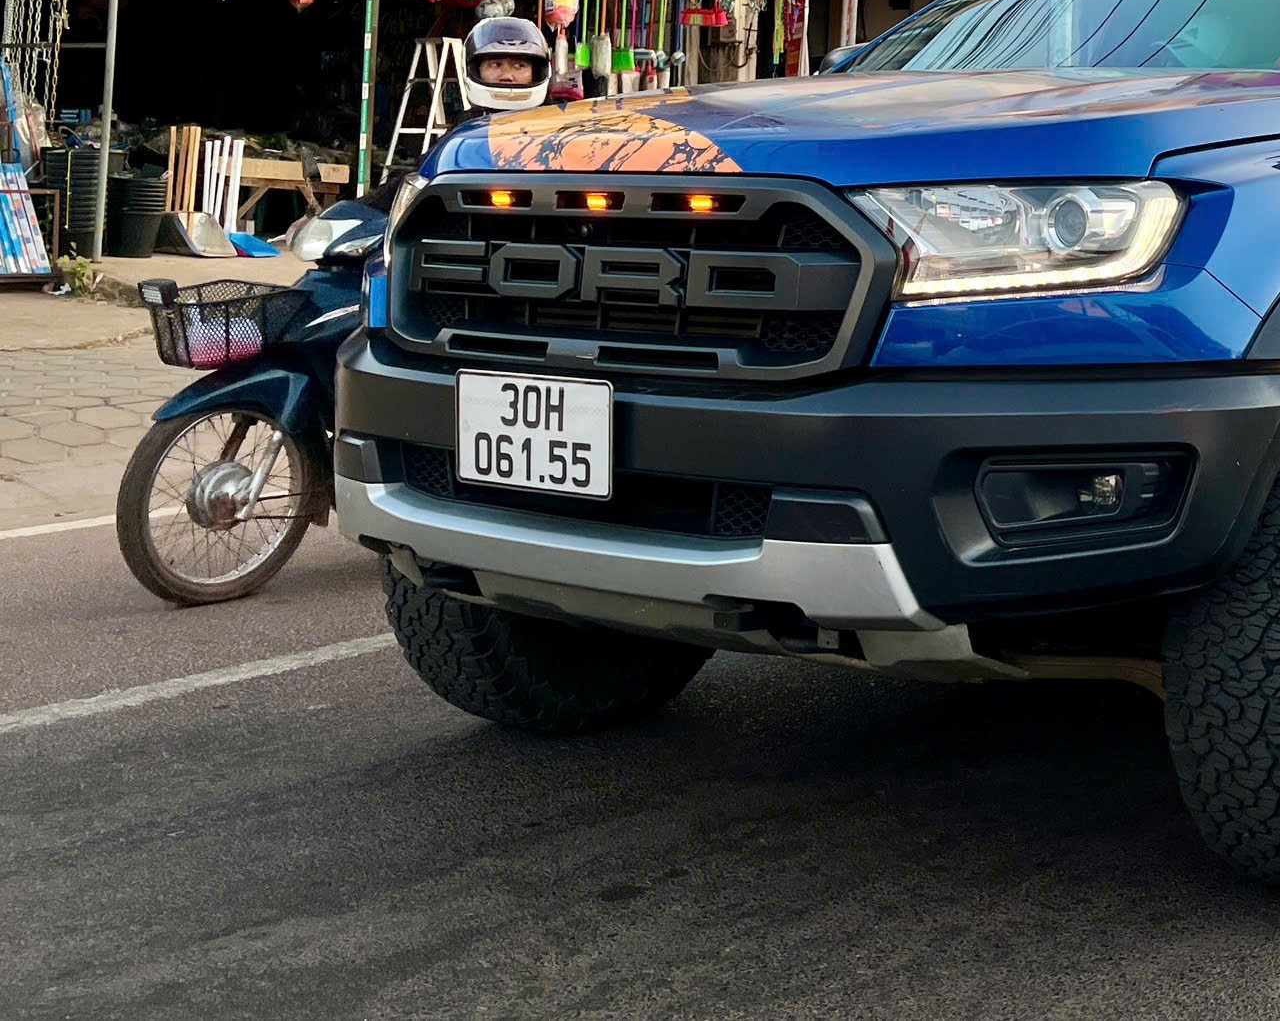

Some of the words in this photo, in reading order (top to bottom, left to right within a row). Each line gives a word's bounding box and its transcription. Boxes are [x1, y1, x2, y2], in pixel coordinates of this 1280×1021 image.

[412, 238, 803, 313] FORD
[500, 382, 565, 432] 30H
[473, 432, 592, 489] 061.55
